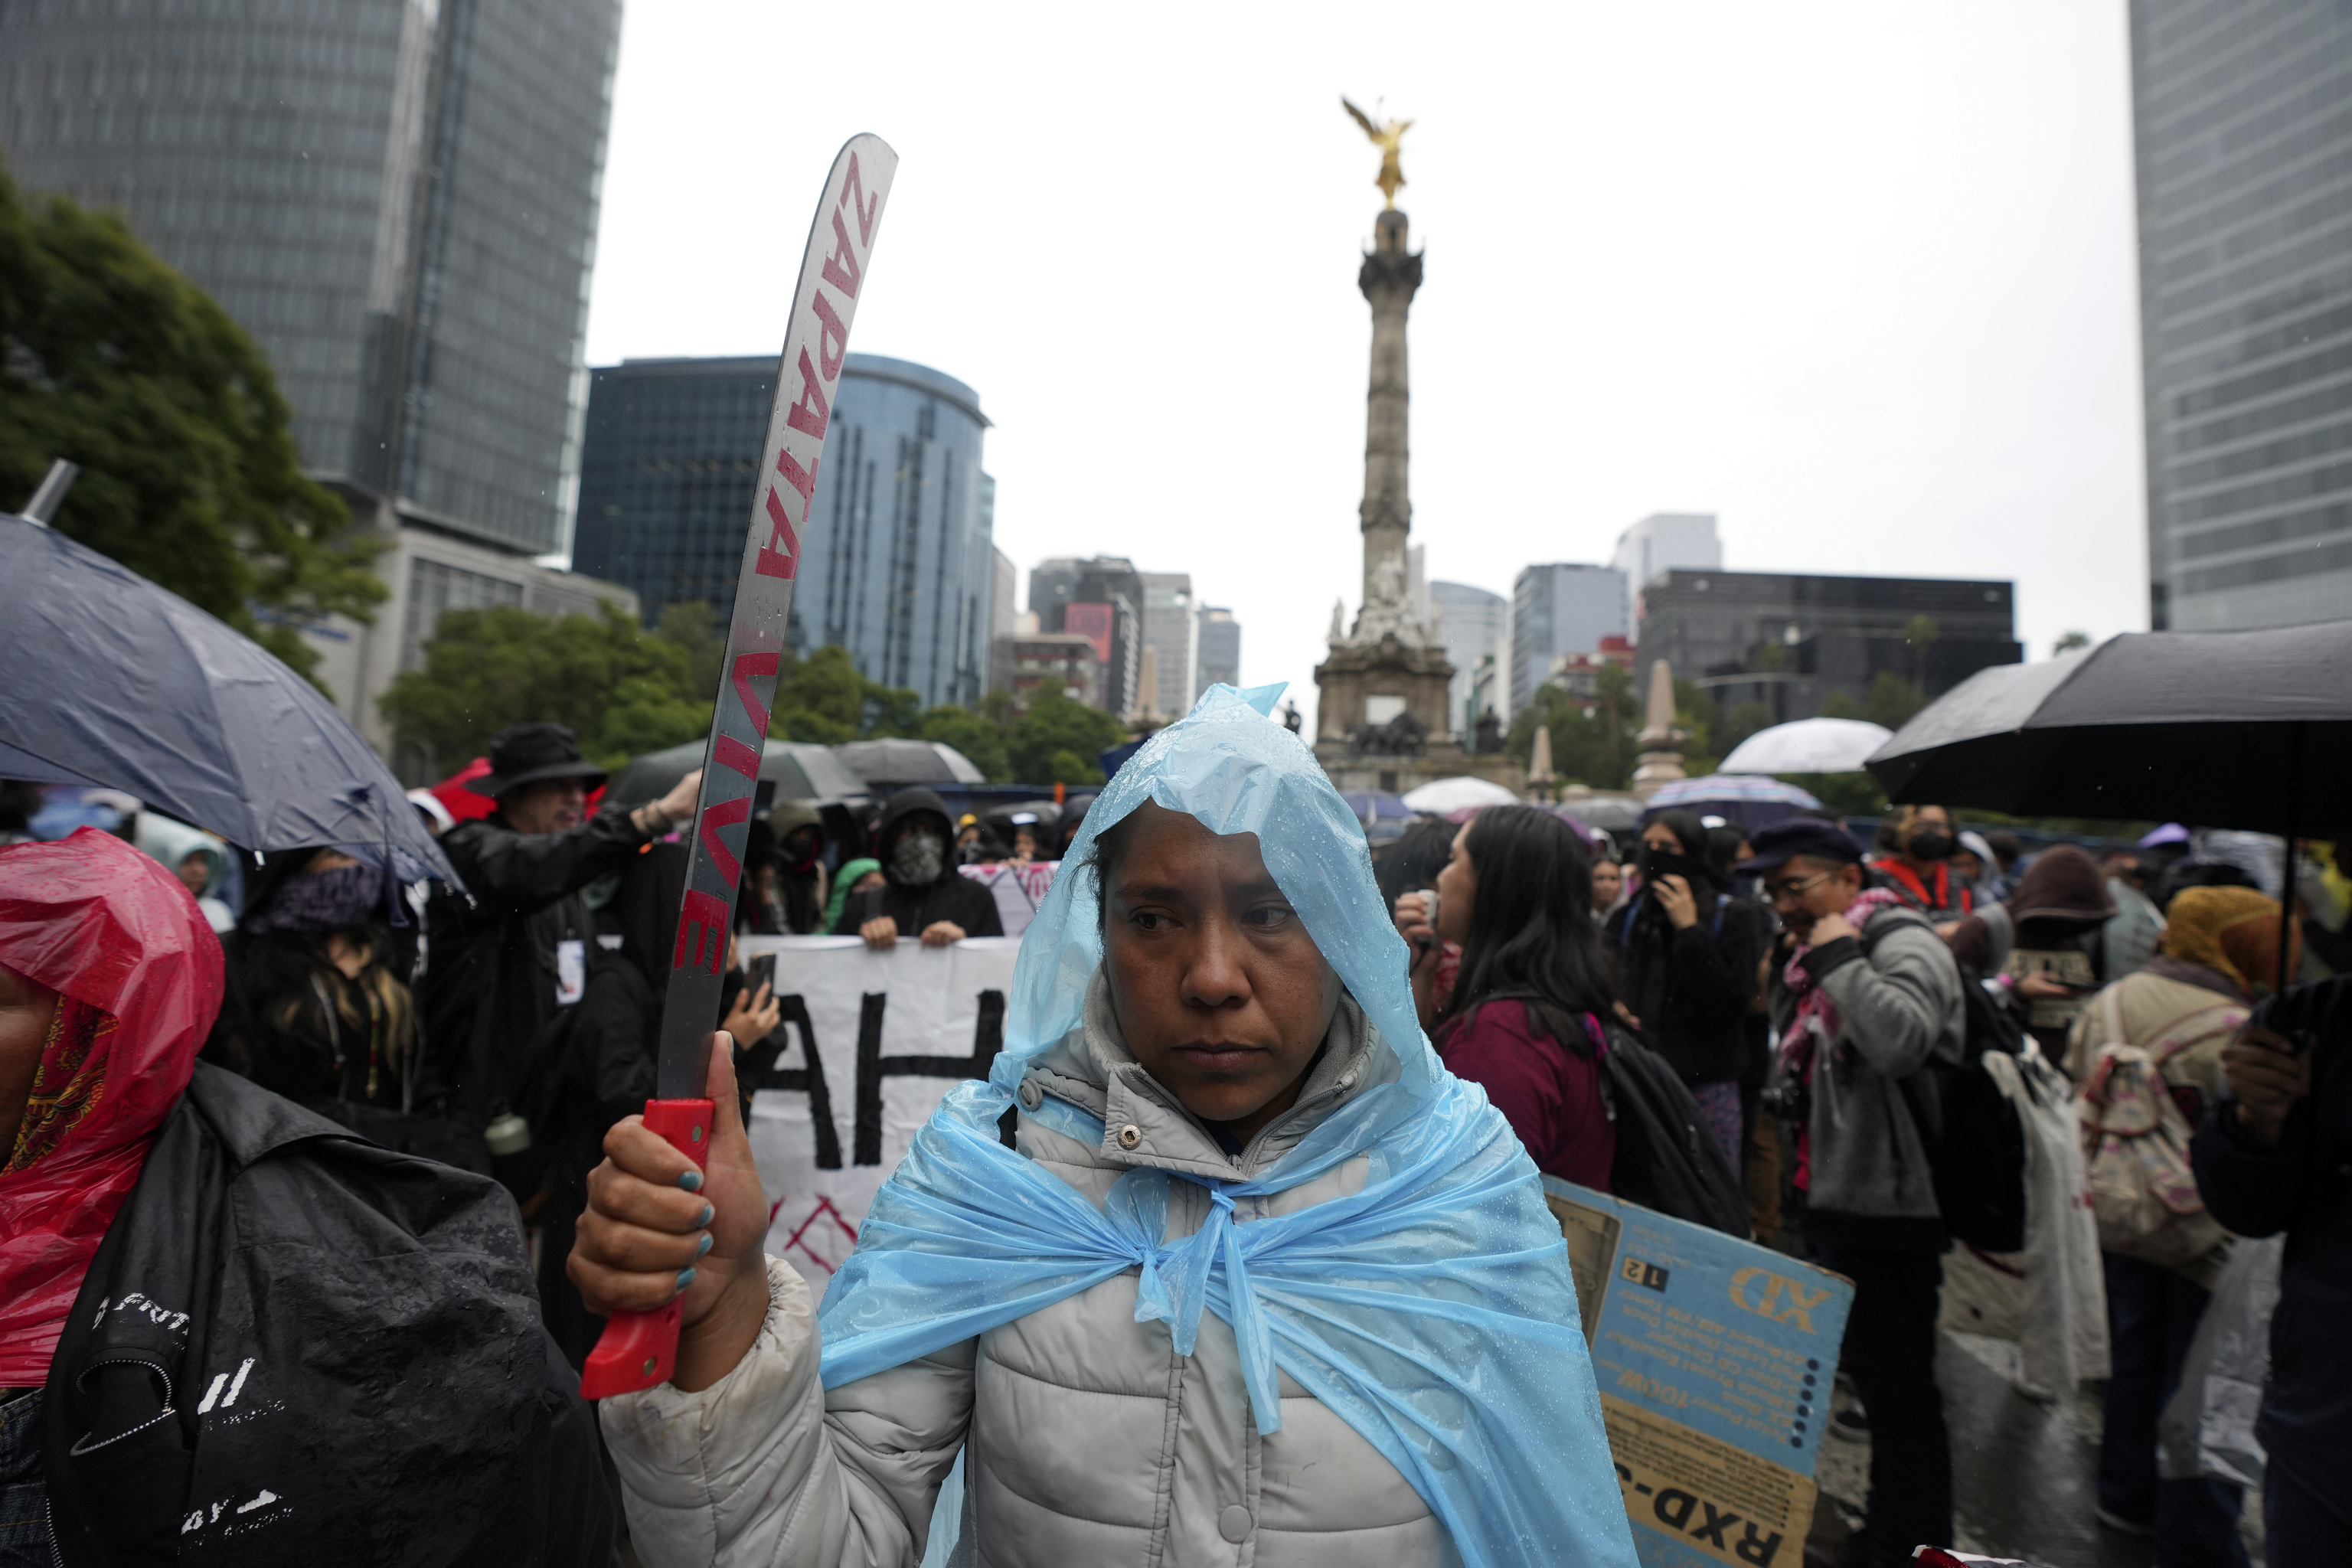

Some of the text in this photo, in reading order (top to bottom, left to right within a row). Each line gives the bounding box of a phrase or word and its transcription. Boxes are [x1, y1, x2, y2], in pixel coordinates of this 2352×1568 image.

[675, 150, 878, 975] ZAPATA VIVE
[1729, 1266, 1834, 1334] XD
